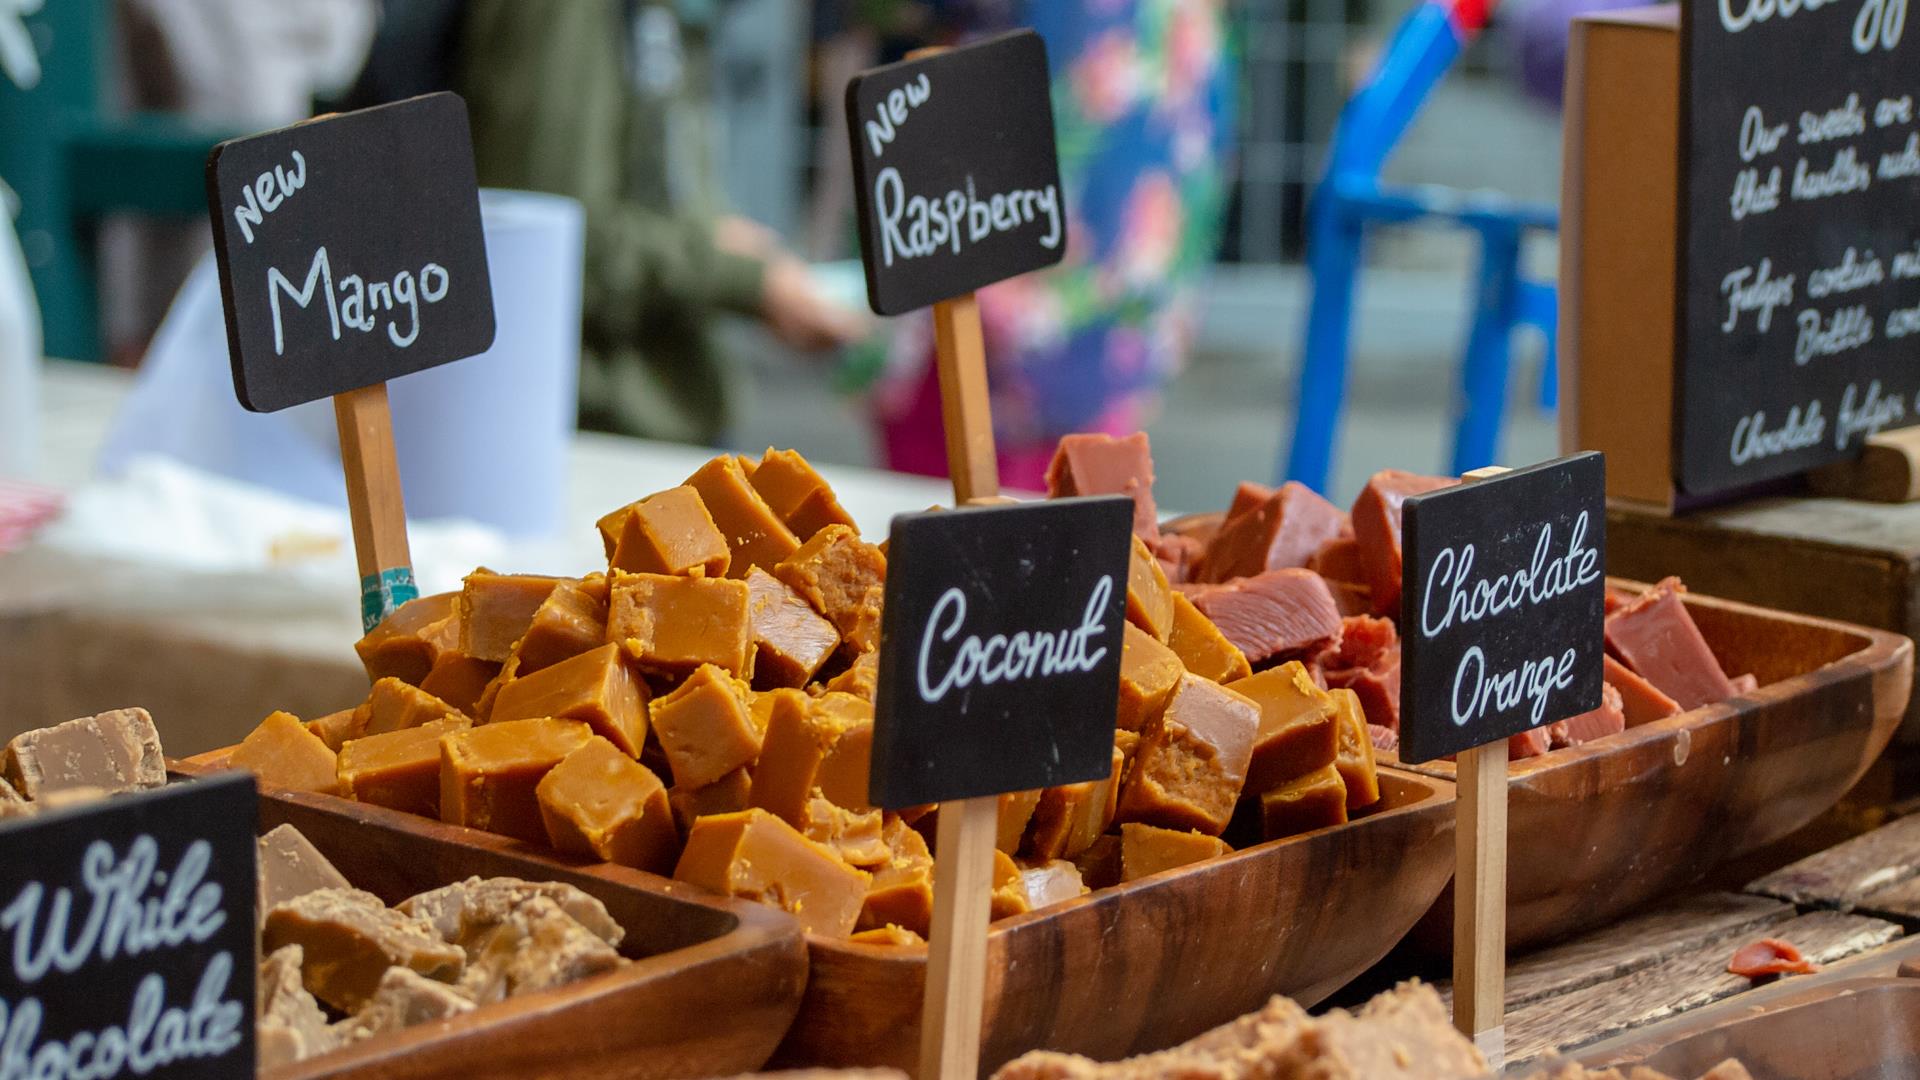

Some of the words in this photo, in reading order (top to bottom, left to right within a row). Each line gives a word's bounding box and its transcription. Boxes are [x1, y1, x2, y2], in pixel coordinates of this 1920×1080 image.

[865, 73, 931, 157] New
[1739, 105, 1788, 162] Our
[1797, 93, 1866, 144] sweets
[1874, 95, 1913, 127] are
[234, 150, 307, 243] New
[875, 167, 1061, 268] Raspberry
[1730, 165, 1782, 220] that
[267, 246, 450, 356] Mango
[1795, 305, 1874, 366] Brittle
[1730, 399, 1826, 465] Chocolate
[1421, 510, 1600, 637] Chocolate
[917, 574, 1112, 703] Coconut
[1451, 645, 1576, 727] Orange
[0, 834, 228, 982] White
[0, 951, 243, 1080] hocolate
